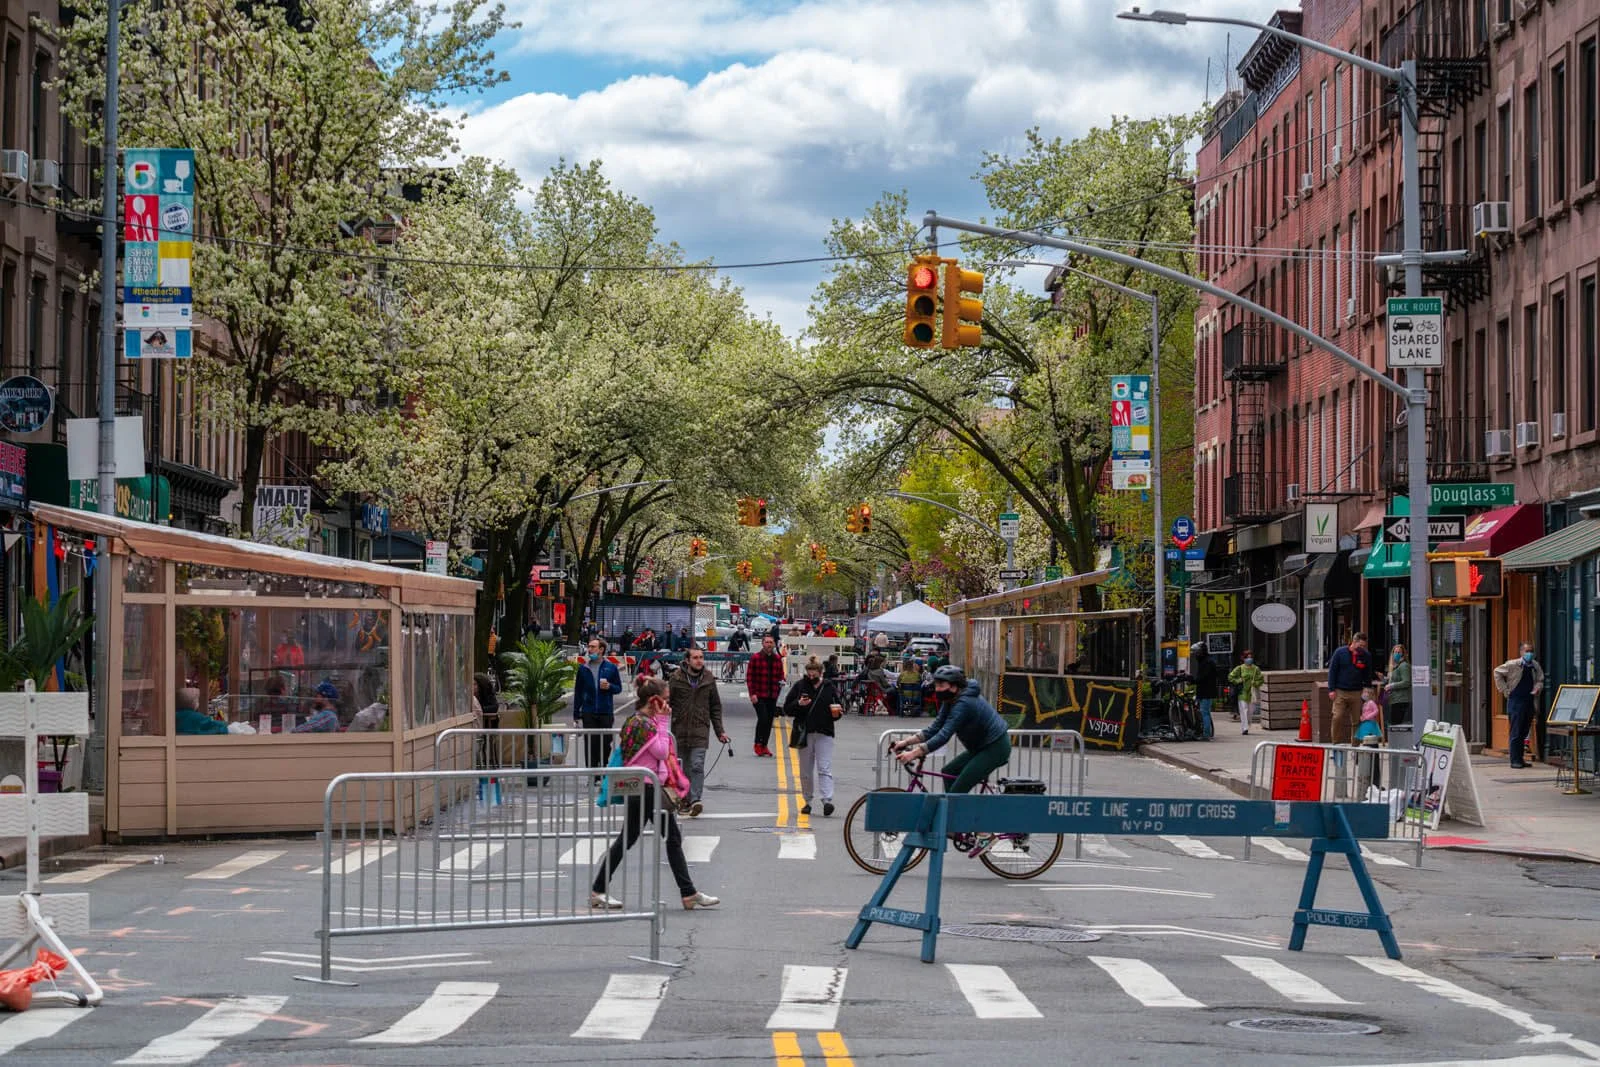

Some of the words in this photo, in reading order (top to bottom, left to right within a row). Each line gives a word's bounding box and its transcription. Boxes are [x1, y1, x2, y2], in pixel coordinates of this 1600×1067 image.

[130, 248, 153, 257] SHOP
[128, 256, 154, 266] SMALL
[128, 265, 153, 274] EVERY
[133, 273, 149, 282] DAY
[1390, 303, 1409, 312] BIKE
[1413, 303, 1439, 312] ROUTE
[1391, 335, 1440, 345] SHARED
[1399, 348, 1432, 359] LANE
[258, 488, 308, 506] MADE
[1433, 486, 1497, 505] Douglass
[1395, 522, 1411, 535] ON
[1430, 522, 1454, 534] WAY
[1166, 649, 1173, 658] P
[1281, 751, 1293, 763] NO
[1297, 752, 1319, 764] THRU
[1280, 764, 1317, 777] TRAFFIC
[1048, 801, 1091, 816] POLICE
[1102, 802, 1129, 817] LINE
[1149, 803, 1164, 817] DO
[1169, 803, 1193, 818] NOT
[1198, 804, 1236, 819] CROSS
[1122, 820, 1163, 831] NYPD
[869, 907, 897, 921] POLICE
[1306, 911, 1340, 925] POLICE
[1344, 915, 1368, 927] DEPT
